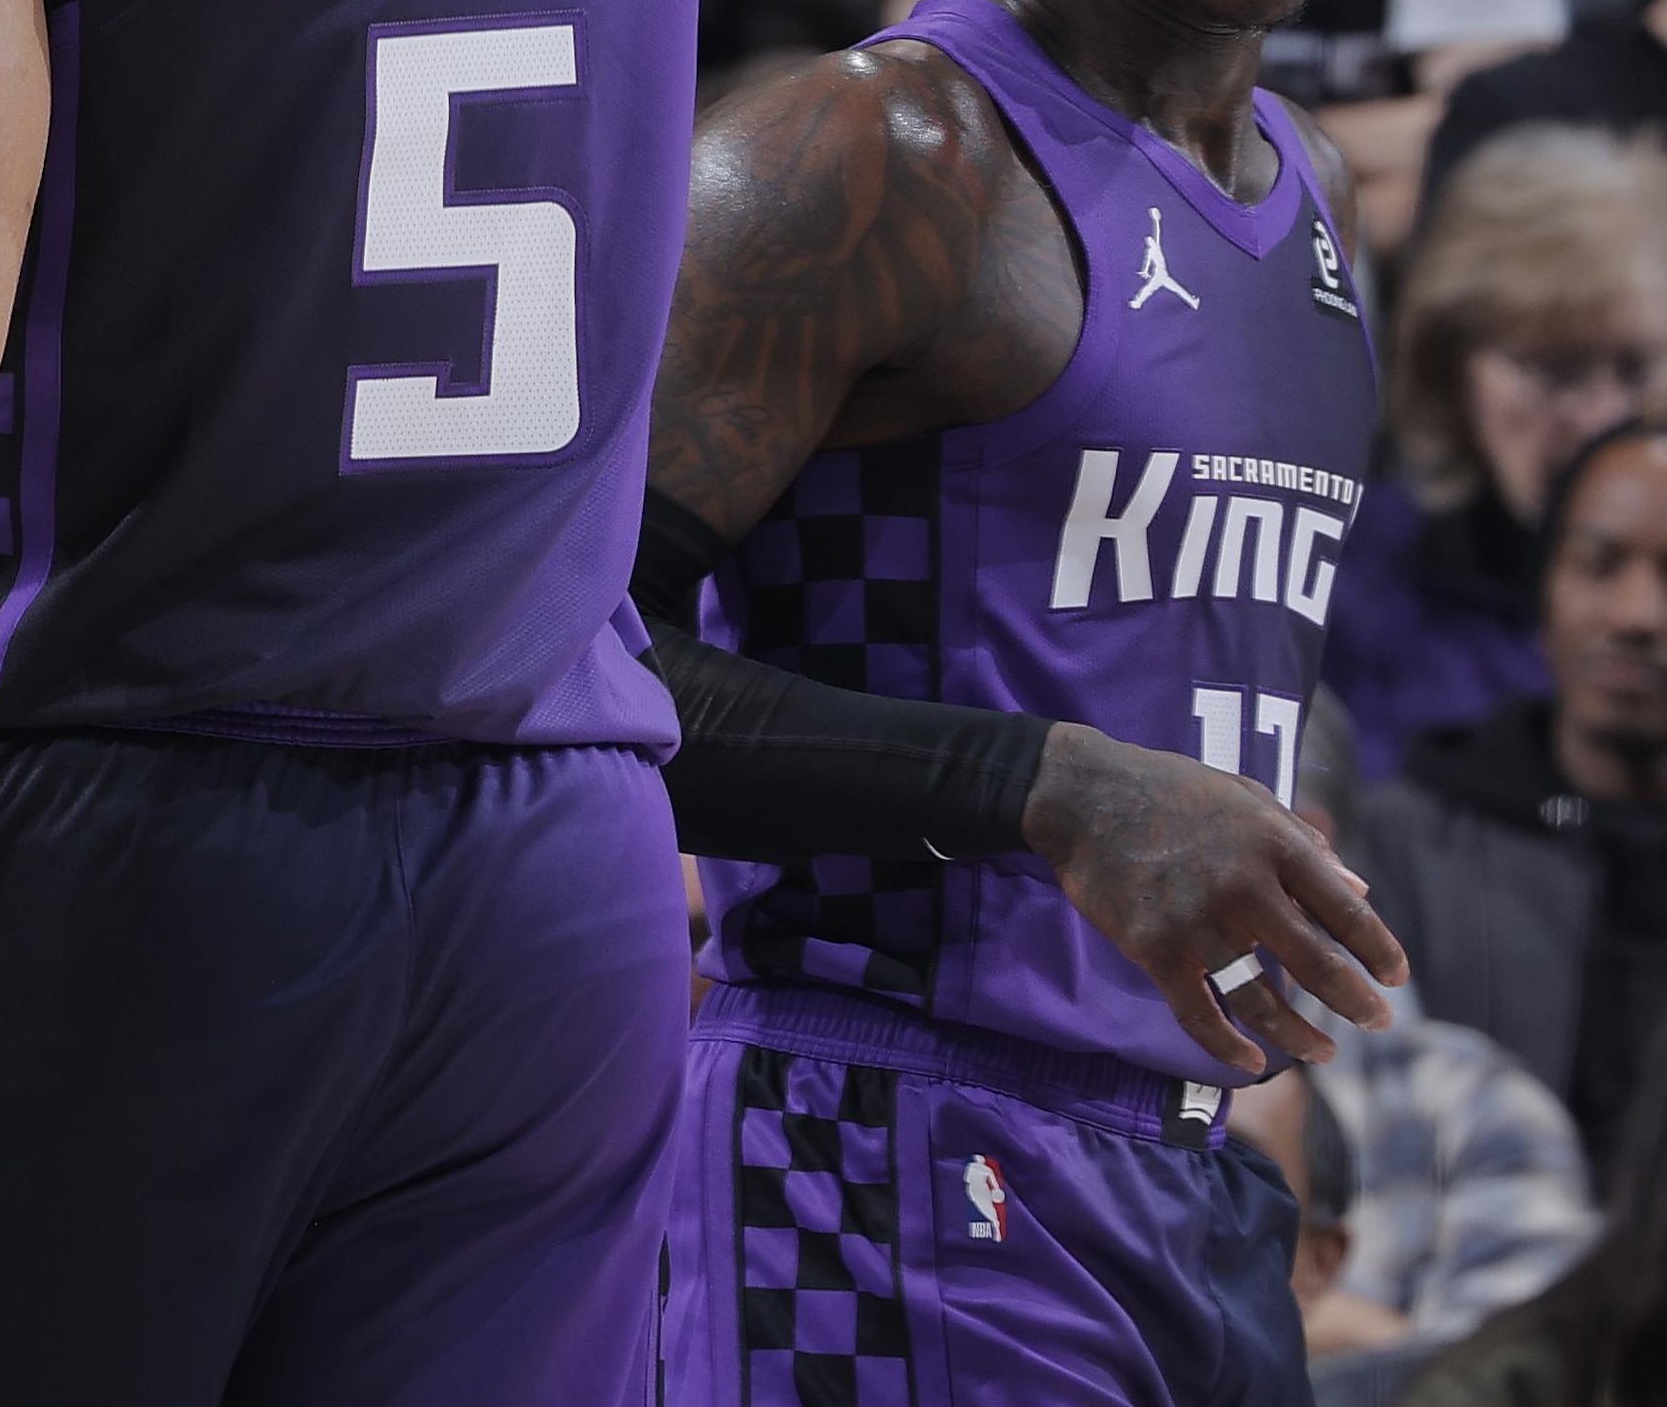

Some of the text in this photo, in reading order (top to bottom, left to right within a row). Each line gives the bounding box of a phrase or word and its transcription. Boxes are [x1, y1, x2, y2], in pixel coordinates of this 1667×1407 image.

[349, 23, 581, 461] 5
[1192, 454, 1356, 505] SACRAMENTO
[1049, 448, 1364, 627] KING
[968, 1221, 993, 1239] NBA
